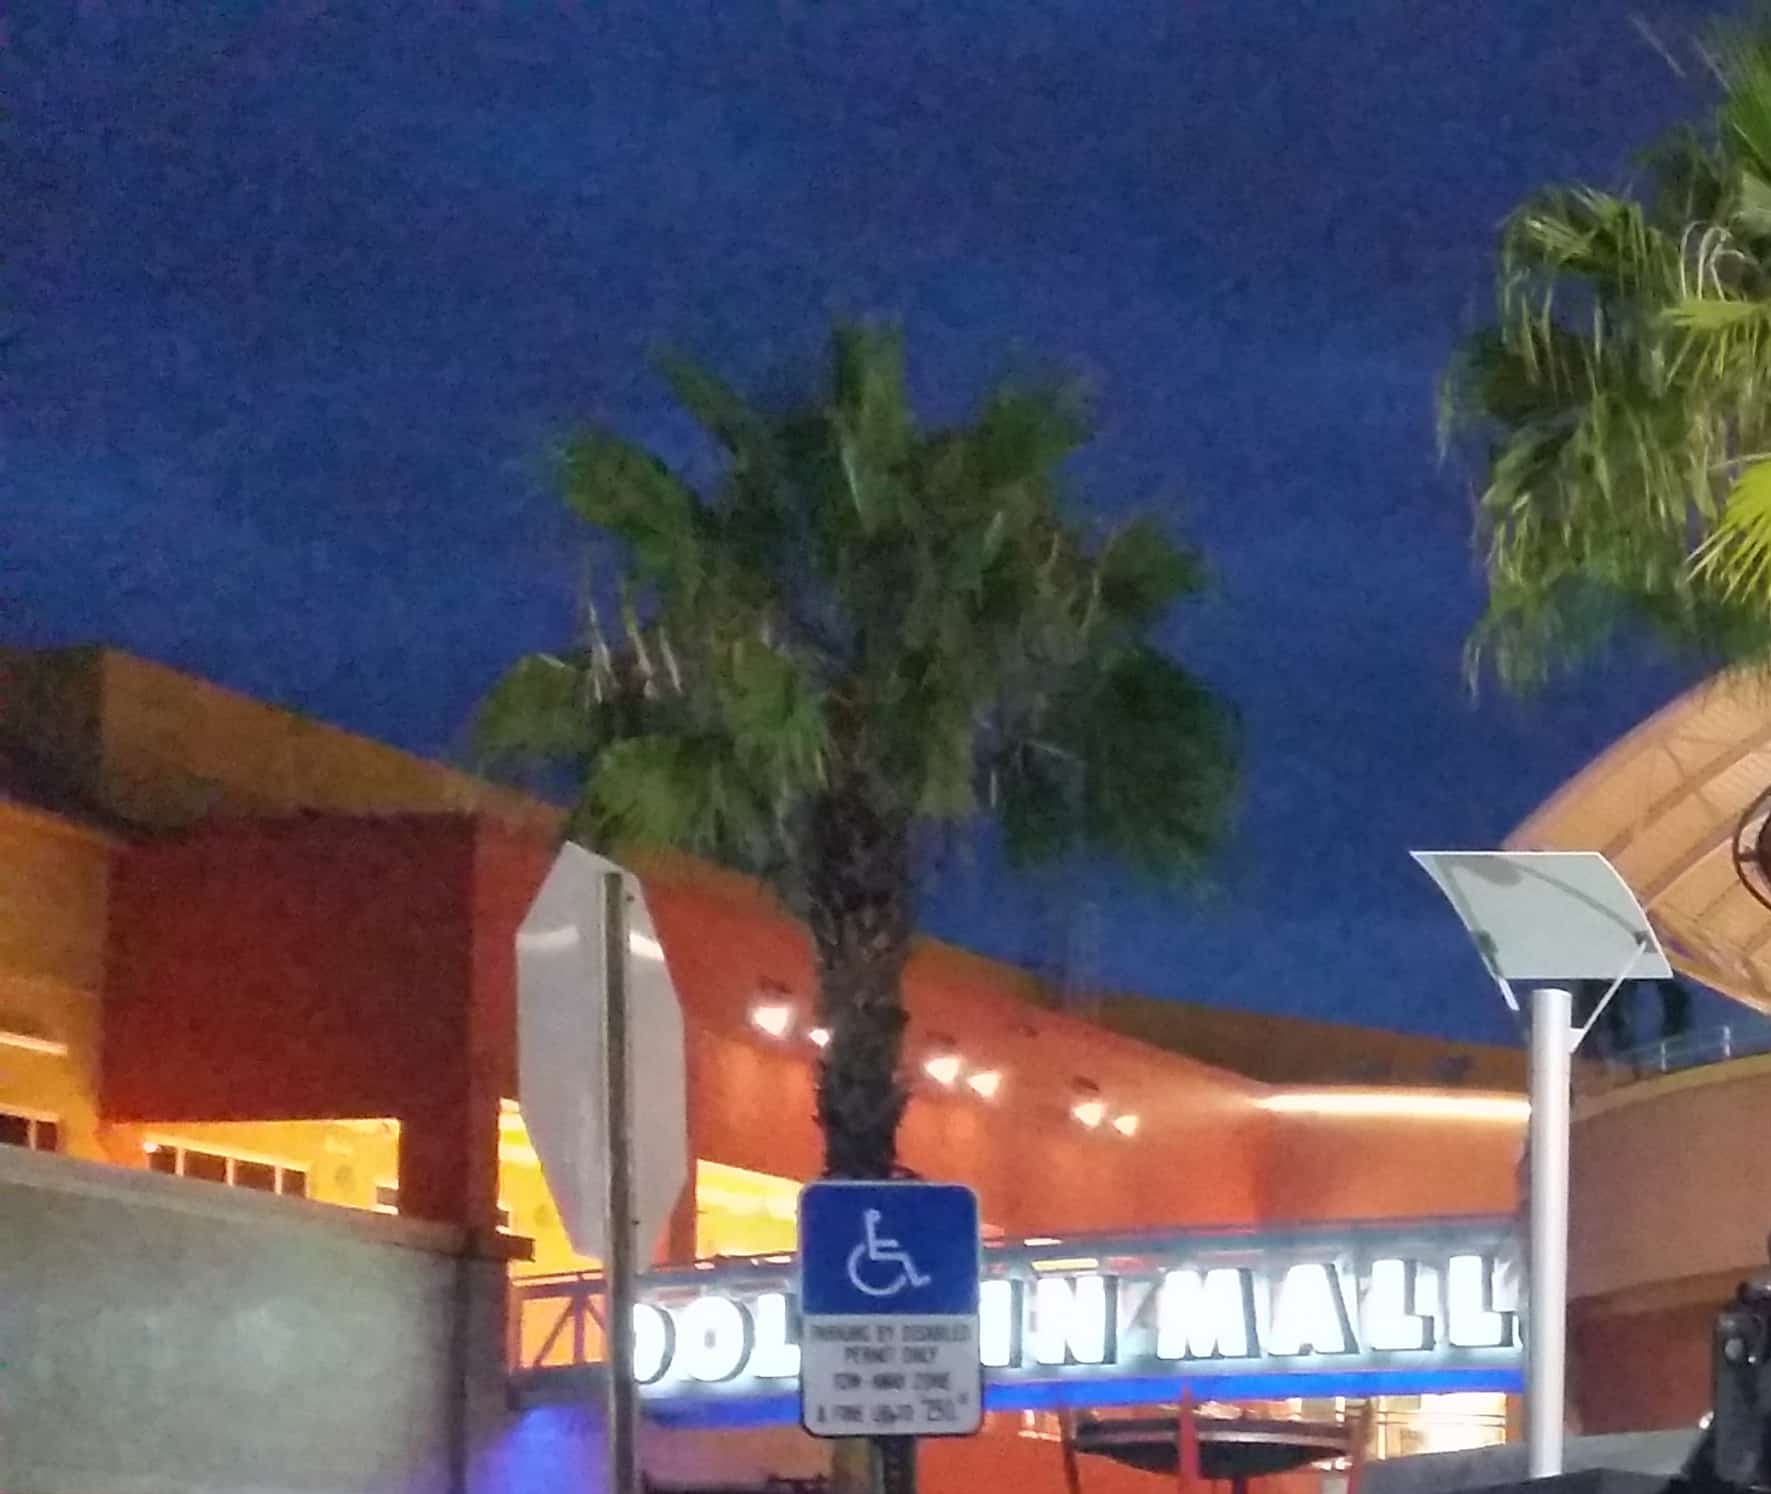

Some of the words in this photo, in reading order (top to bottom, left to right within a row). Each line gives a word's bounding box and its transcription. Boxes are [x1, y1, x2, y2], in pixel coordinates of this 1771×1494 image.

[634, 1277, 1118, 1384] DOLIN
[1155, 1254, 1522, 1360] MALL
[809, 1324, 870, 1342] PARKING
[876, 1324, 895, 1342] BY
[902, 1324, 971, 1342] DISABLED
[844, 1346, 894, 1364] PERMIT
